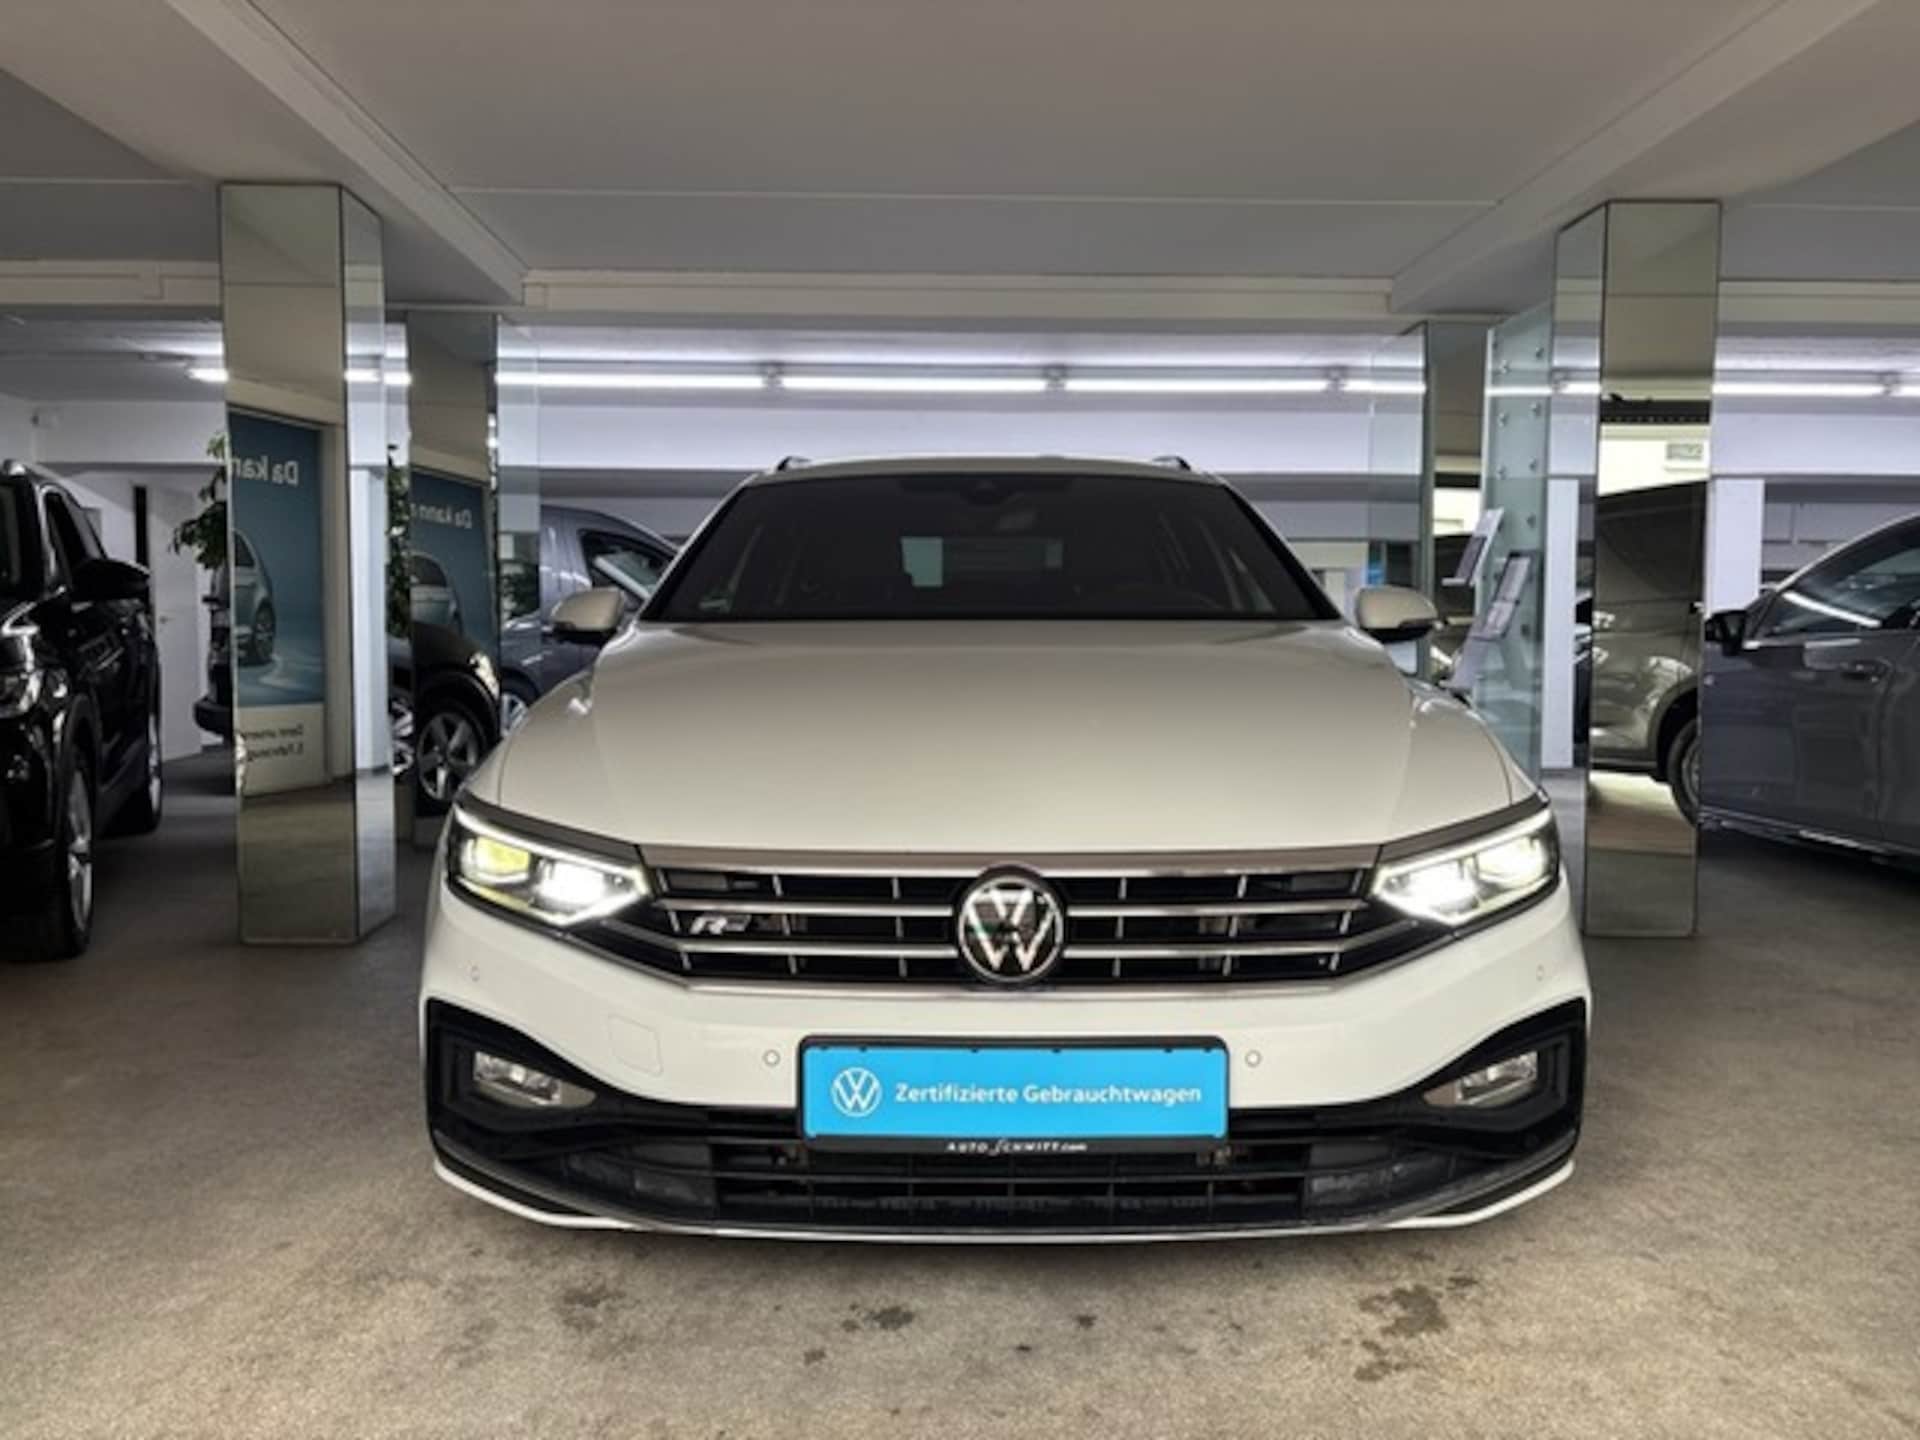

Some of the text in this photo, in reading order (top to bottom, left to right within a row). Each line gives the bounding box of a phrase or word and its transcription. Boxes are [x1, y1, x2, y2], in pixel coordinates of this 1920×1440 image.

[962, 882, 1058, 978] VW
[833, 1068, 880, 1115] VW
[895, 1083, 1202, 1107] Zertifizierte Gebrauchtwagen
[946, 1141, 989, 1154] AUTO
